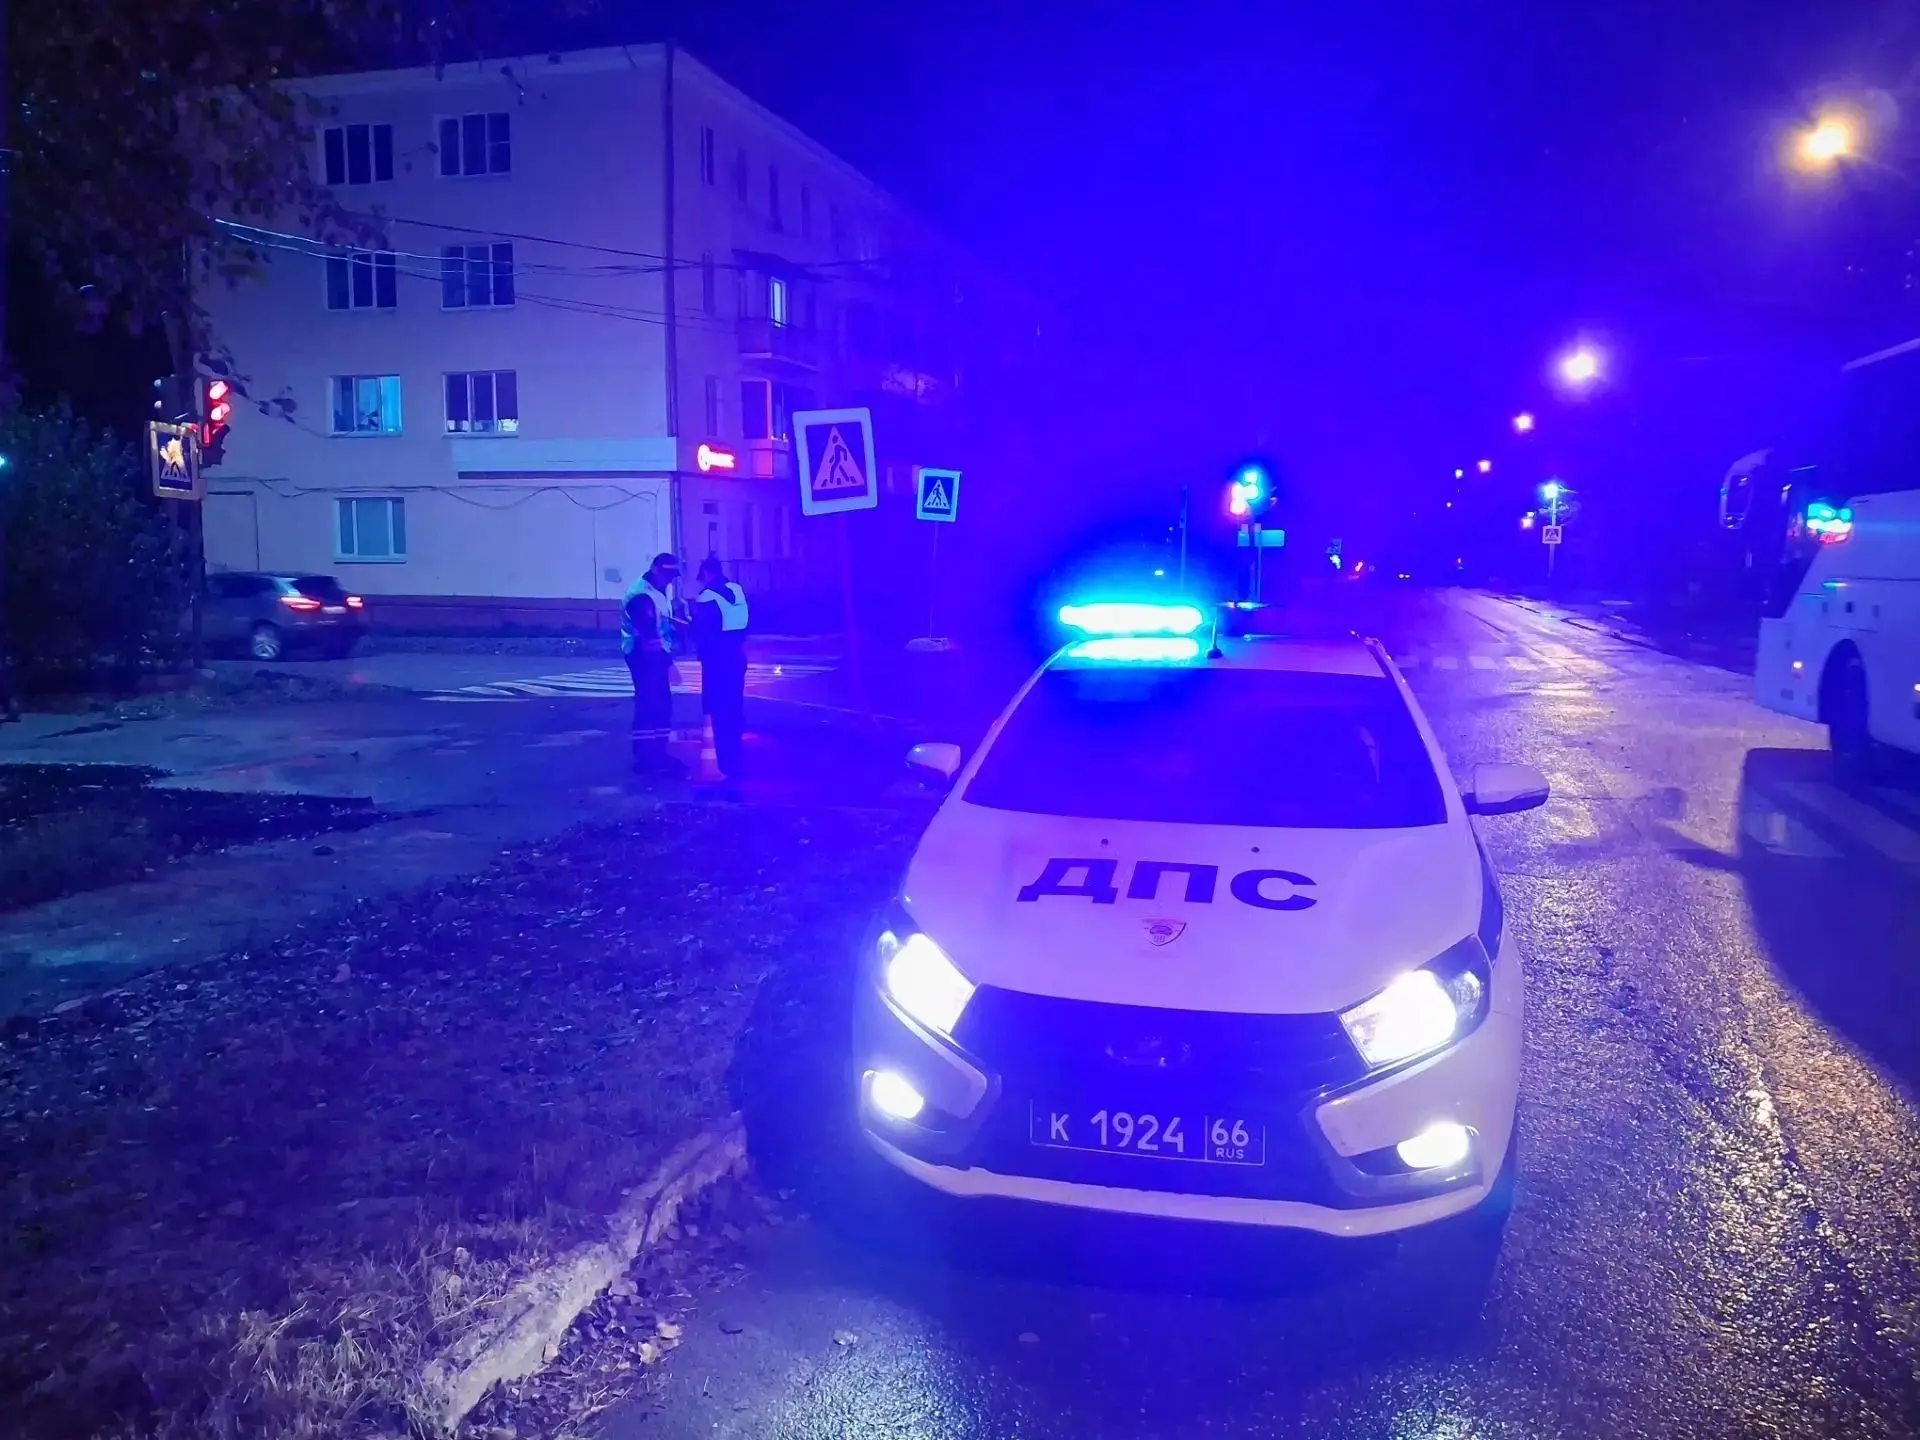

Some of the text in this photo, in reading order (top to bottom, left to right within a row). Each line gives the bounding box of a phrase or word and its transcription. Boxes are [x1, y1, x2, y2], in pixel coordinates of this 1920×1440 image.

[1016, 857, 1318, 911] ДПС
[1090, 1109, 1184, 1153] 1924
[1211, 1119, 1250, 1147] 66
[1215, 1147, 1245, 1160] RUS
